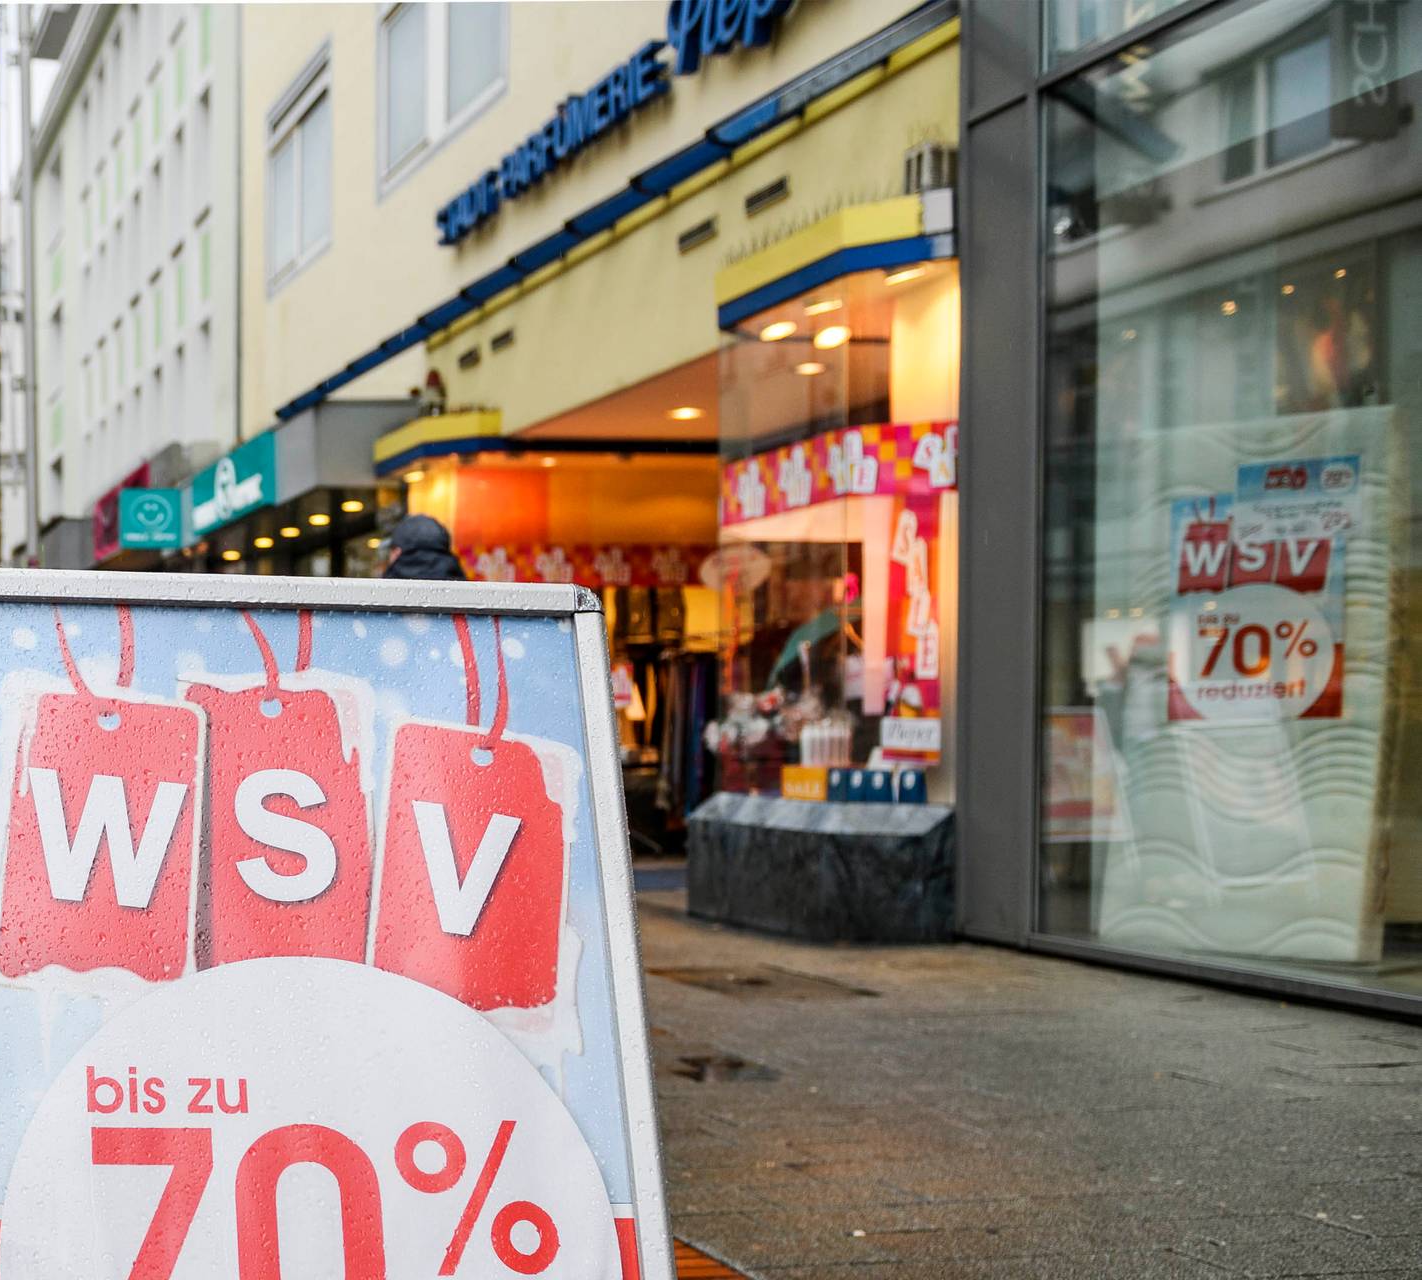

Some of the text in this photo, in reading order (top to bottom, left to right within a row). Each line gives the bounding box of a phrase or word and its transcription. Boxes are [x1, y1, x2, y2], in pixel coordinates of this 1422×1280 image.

[1184, 539, 1320, 577] WSV
[1198, 618, 1319, 679] 70%
[1197, 679, 1307, 700] reduziert
[27, 767, 521, 937] WSV
[86, 1066, 249, 1115] bis zu
[90, 1119, 560, 1280] 70%
